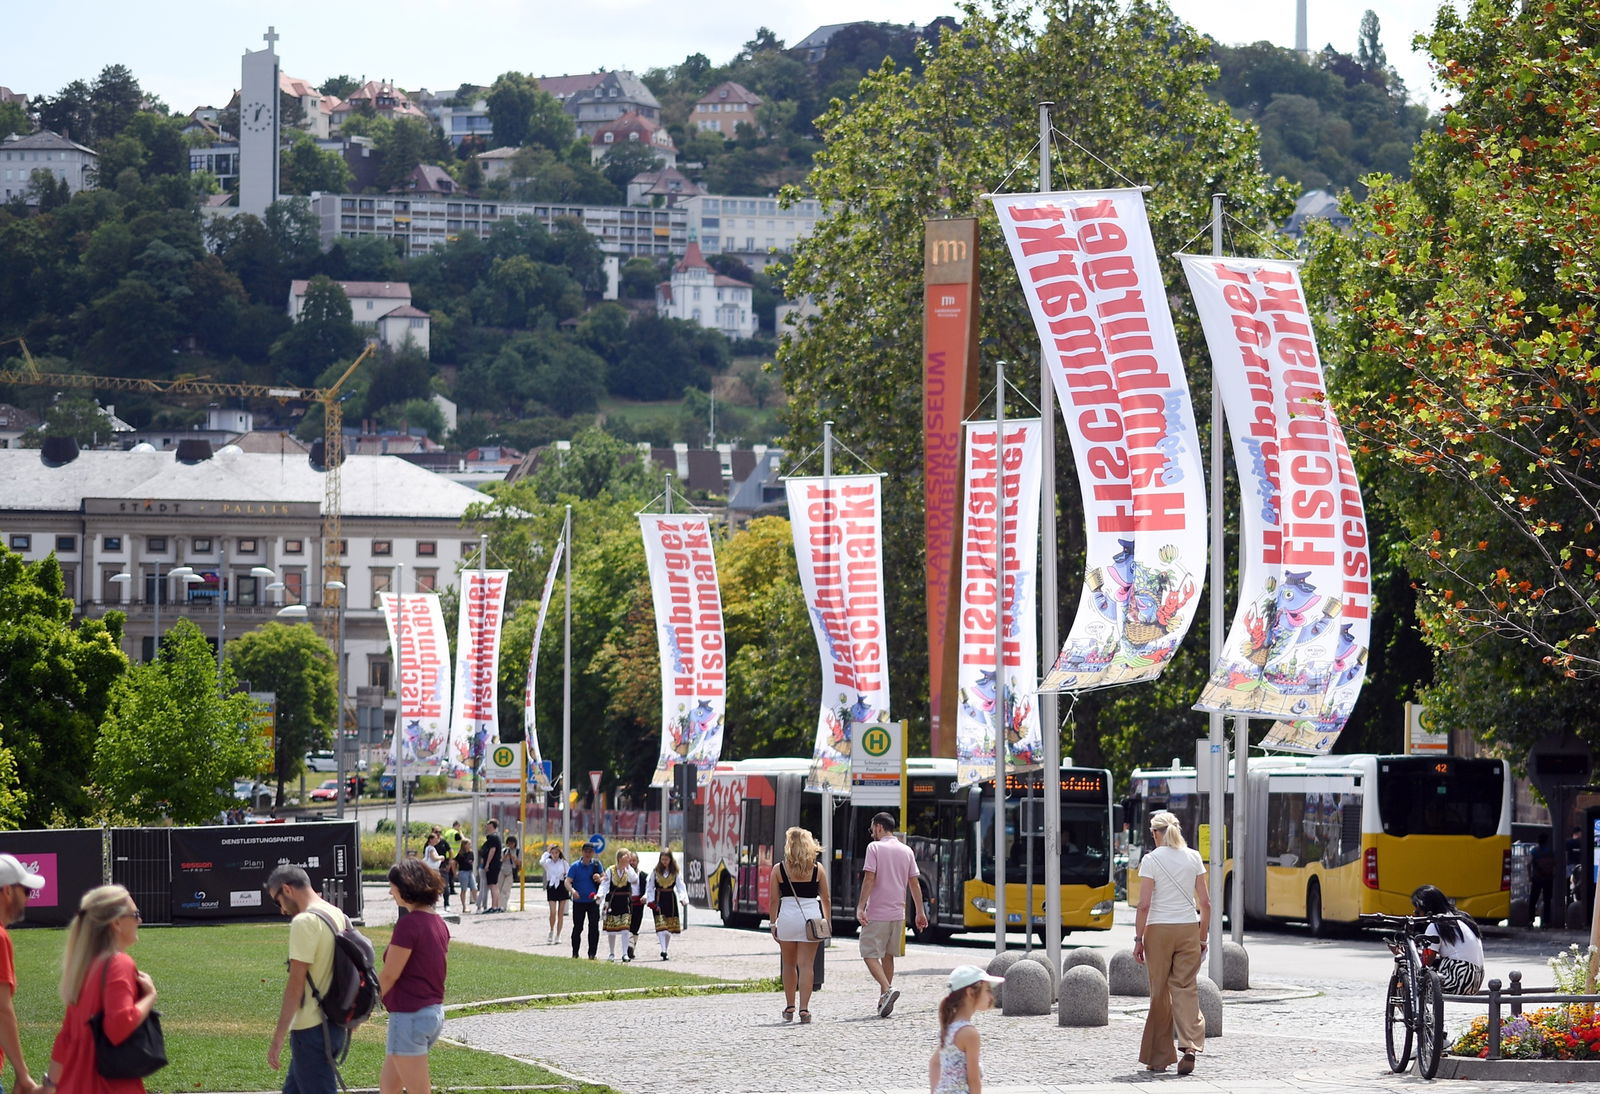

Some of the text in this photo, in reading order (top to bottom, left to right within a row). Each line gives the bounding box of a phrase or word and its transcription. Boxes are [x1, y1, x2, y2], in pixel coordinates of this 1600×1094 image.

[927, 351, 945, 585] LANDESMUSEUM
[1211, 262, 1283, 564] Hamburger
[1253, 266, 1336, 567] Fischmarkt
[119, 502, 289, 513] STADT PALAIS
[806, 484, 855, 688] Hamburger
[840, 482, 882, 692] Fischmarkt
[481, 576, 505, 721] Fischmarkt
[657, 519, 695, 696] Hamburger
[682, 521, 724, 697] Fischmarkt
[221, 835, 305, 845] DIENSTLEISTUNGSPARTNER
[1434, 763, 1448, 772] 42
[689, 860, 701, 881] SSB
